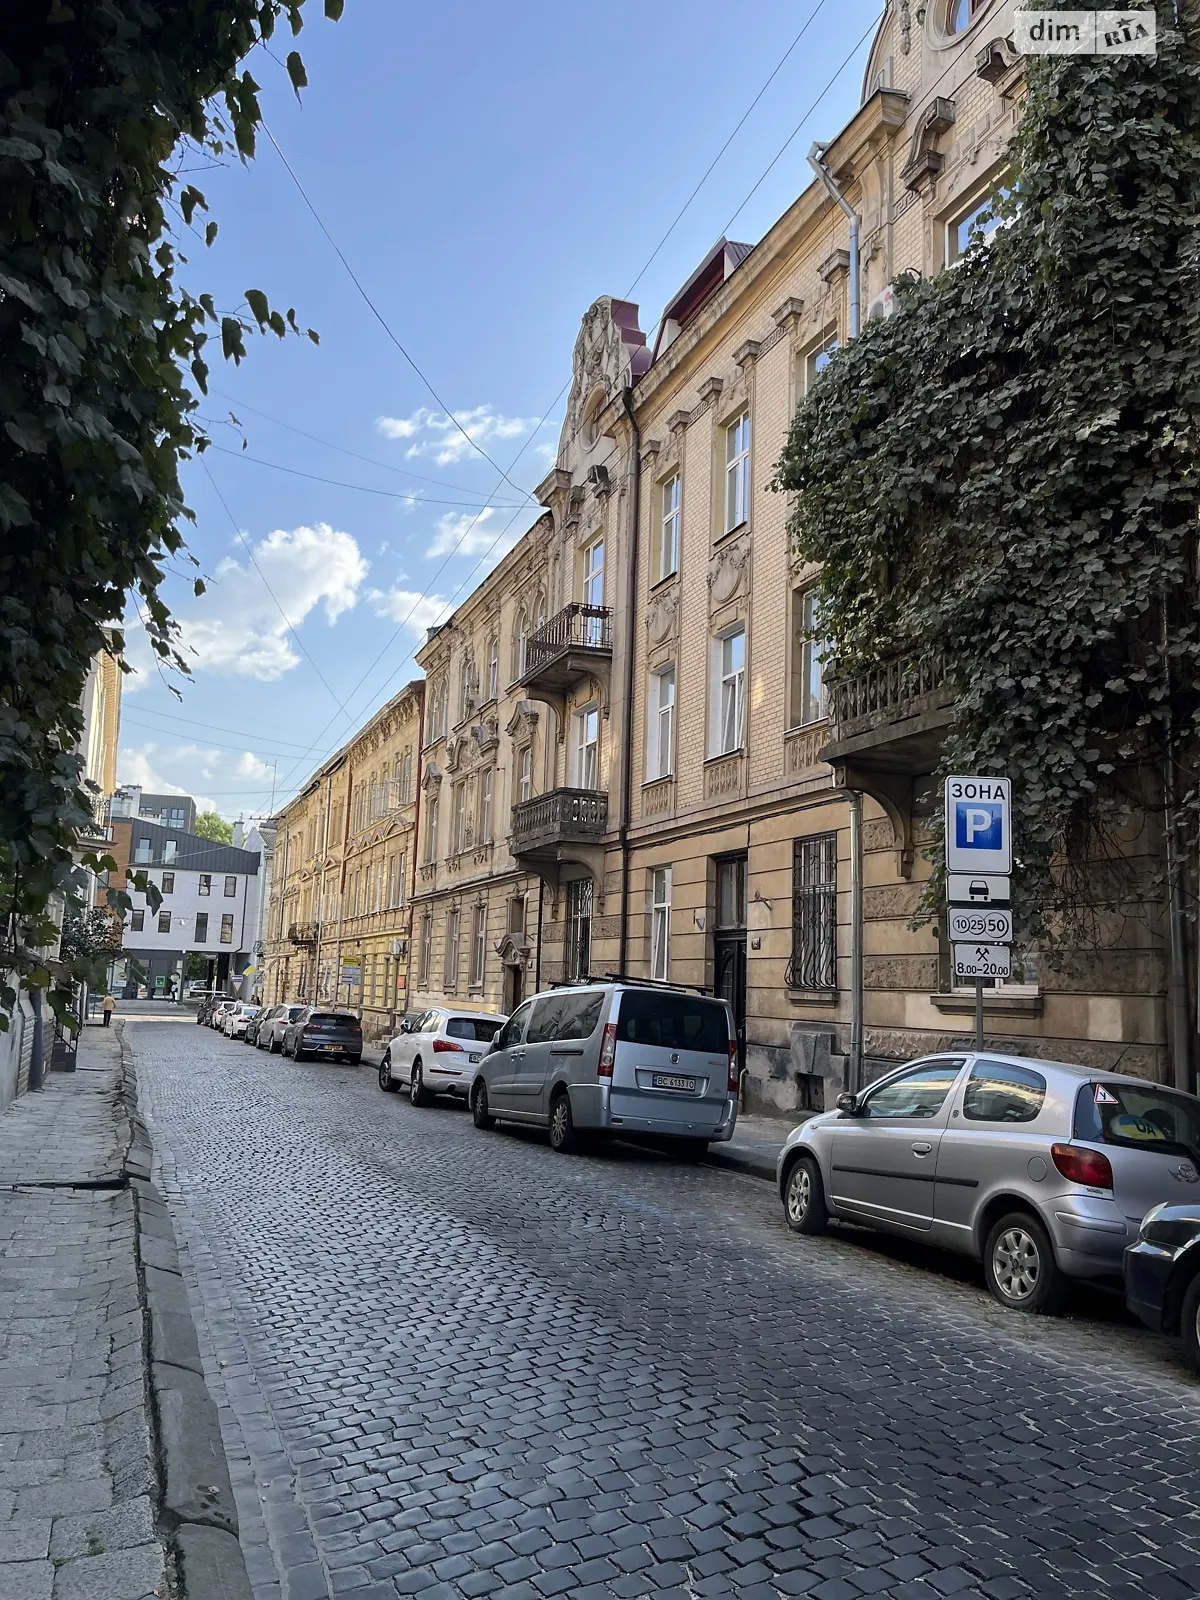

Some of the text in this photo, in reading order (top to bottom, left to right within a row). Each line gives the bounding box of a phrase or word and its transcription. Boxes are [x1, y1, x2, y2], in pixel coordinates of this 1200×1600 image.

[952, 783, 1006, 800] ЗОНА
[966, 808, 992, 843] P
[956, 919, 1005, 932] 10 25 50
[669, 1078, 685, 1087] 6133
[1132, 1119, 1158, 1138] UA
